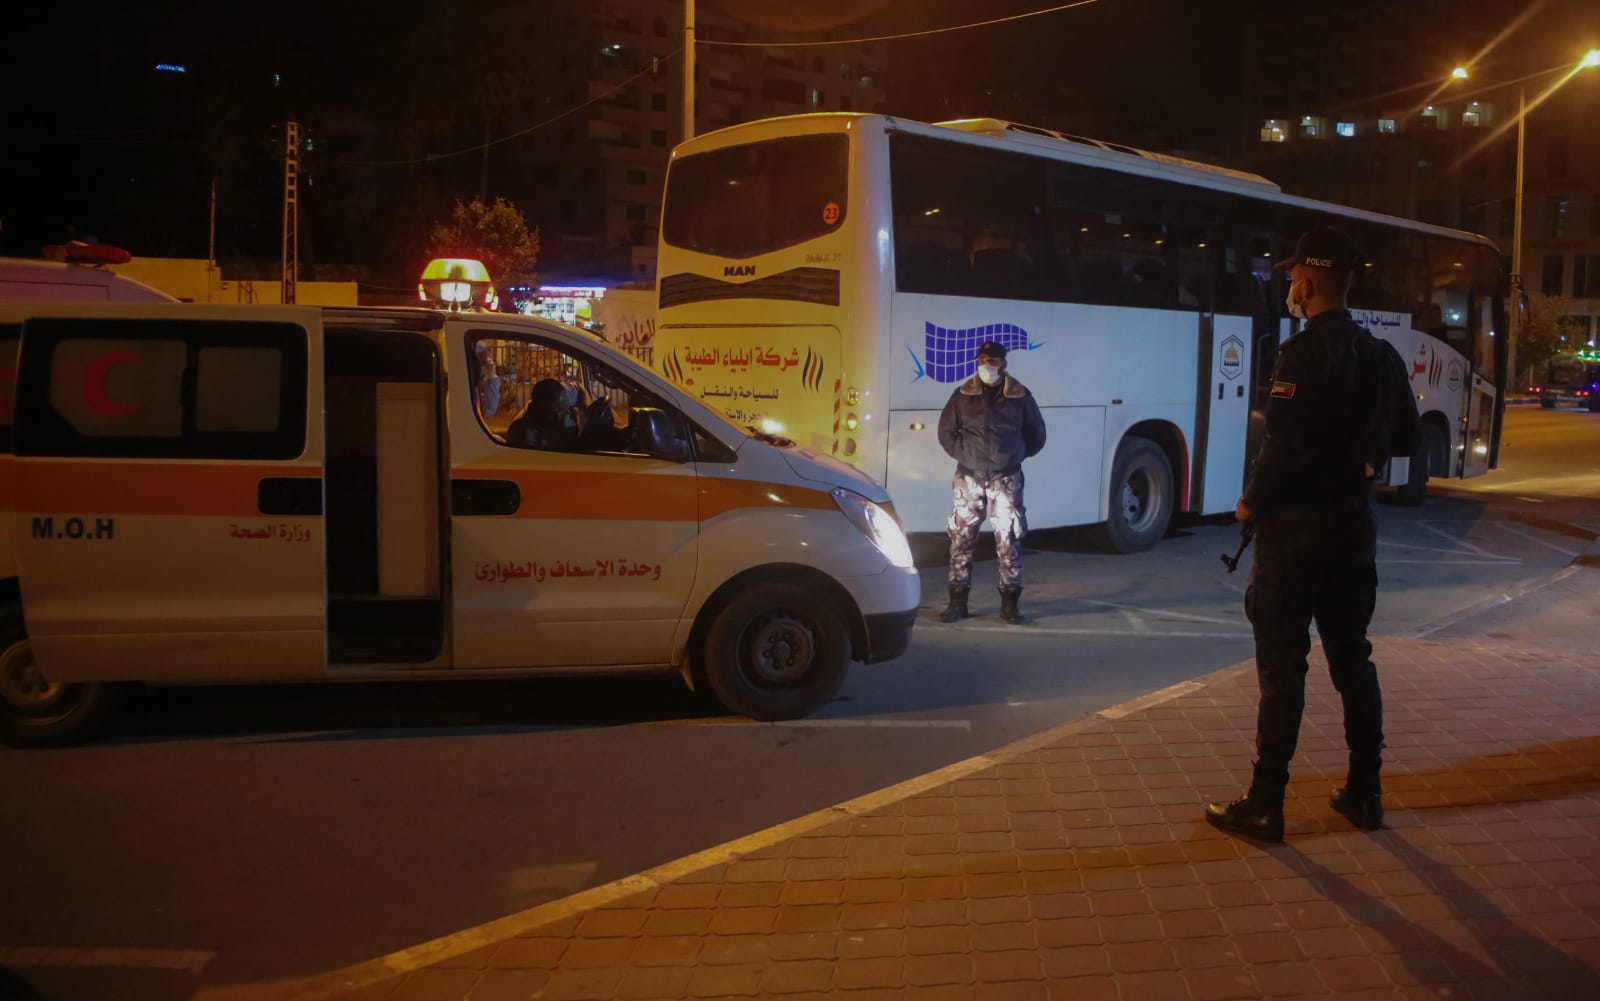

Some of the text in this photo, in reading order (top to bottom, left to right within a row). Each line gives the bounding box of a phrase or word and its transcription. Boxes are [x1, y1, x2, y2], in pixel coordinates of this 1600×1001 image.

[825, 207, 838, 220] 23
[724, 265, 756, 277] MAN
[1305, 256, 1332, 268] POLICE
[684, 346, 720, 372] الطيبة
[755, 346, 800, 373] شركة
[700, 384, 779, 402] للسياحة والنقل
[32, 517, 115, 540] M.O.H
[230, 523, 312, 543] وزارة الصحة
[618, 558, 662, 581] وحدة
